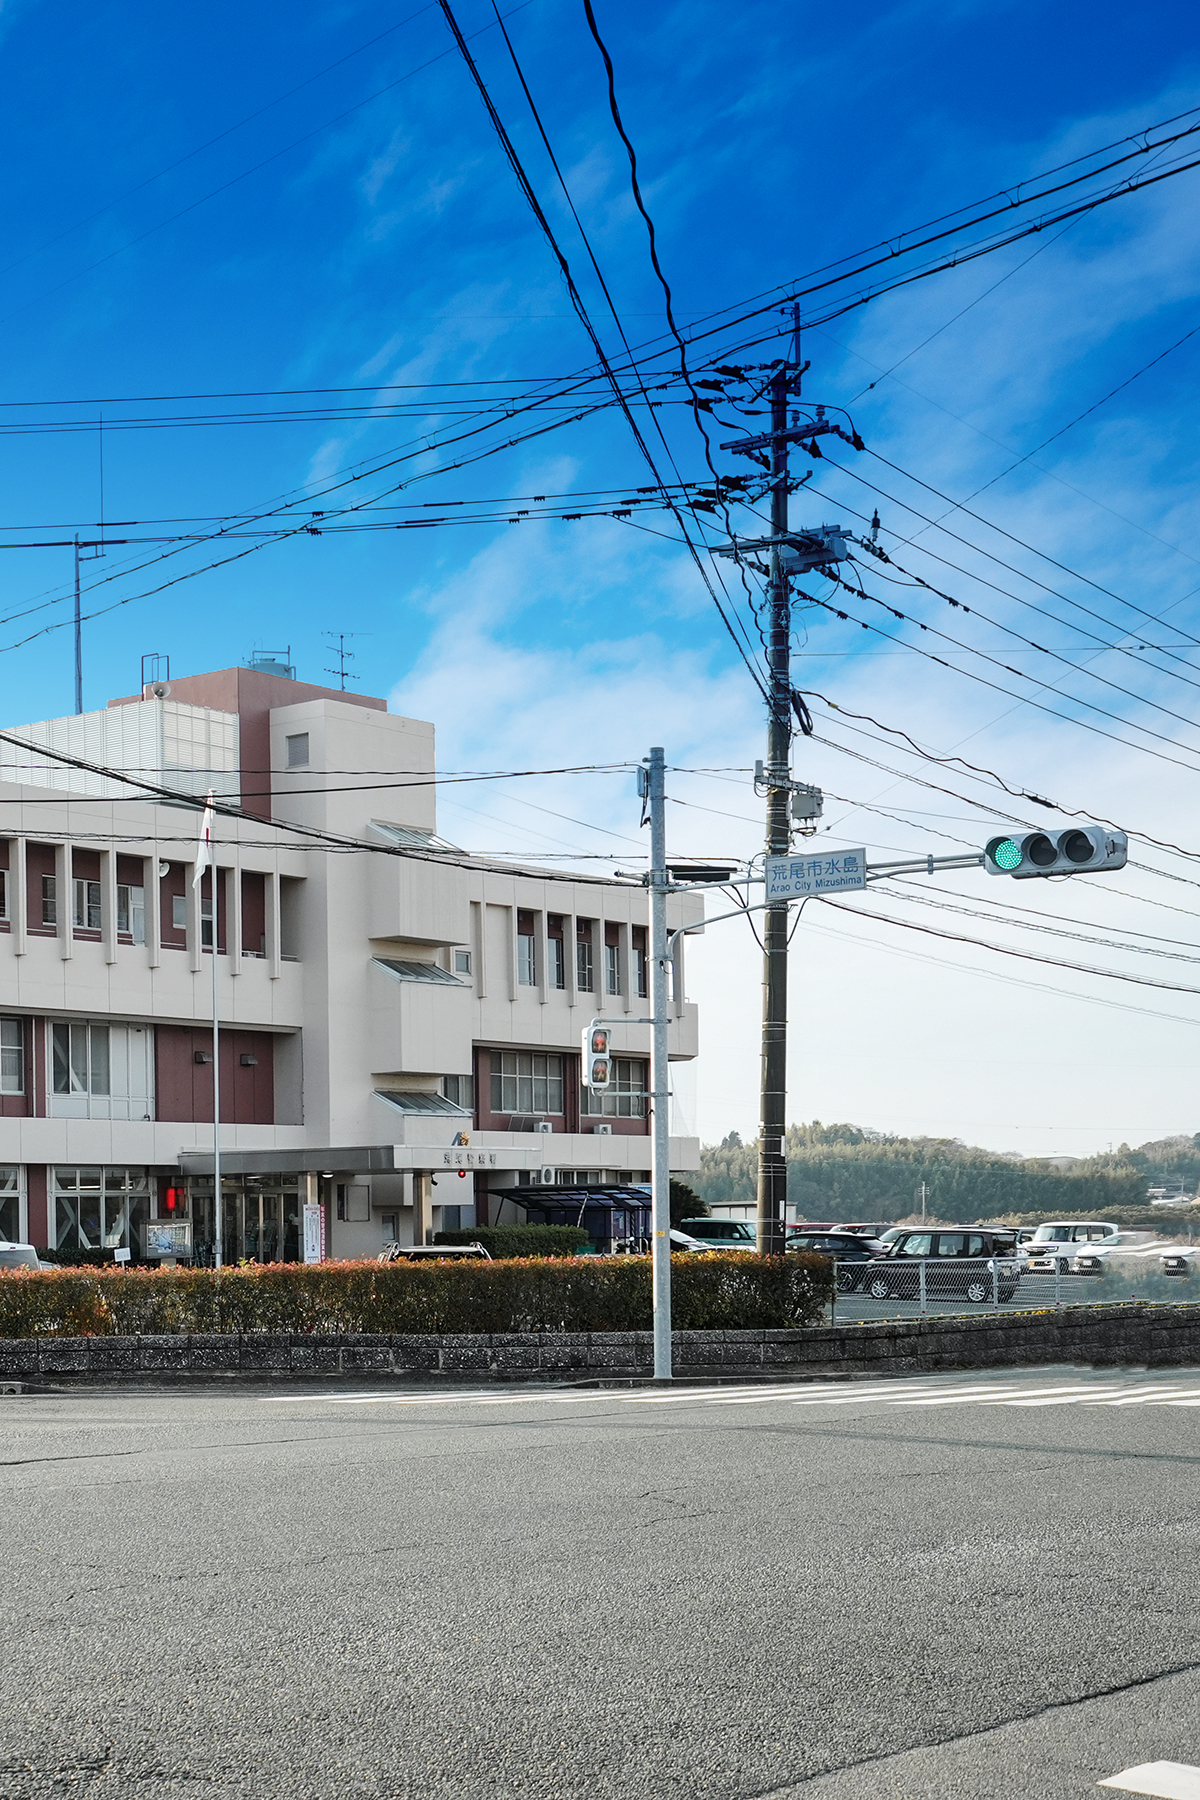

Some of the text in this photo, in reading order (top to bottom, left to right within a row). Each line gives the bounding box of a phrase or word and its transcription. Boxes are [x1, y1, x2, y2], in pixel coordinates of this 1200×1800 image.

[771, 855, 859, 881] 荒尾市水島
[770, 876, 862, 893] Arao City Mizushima
